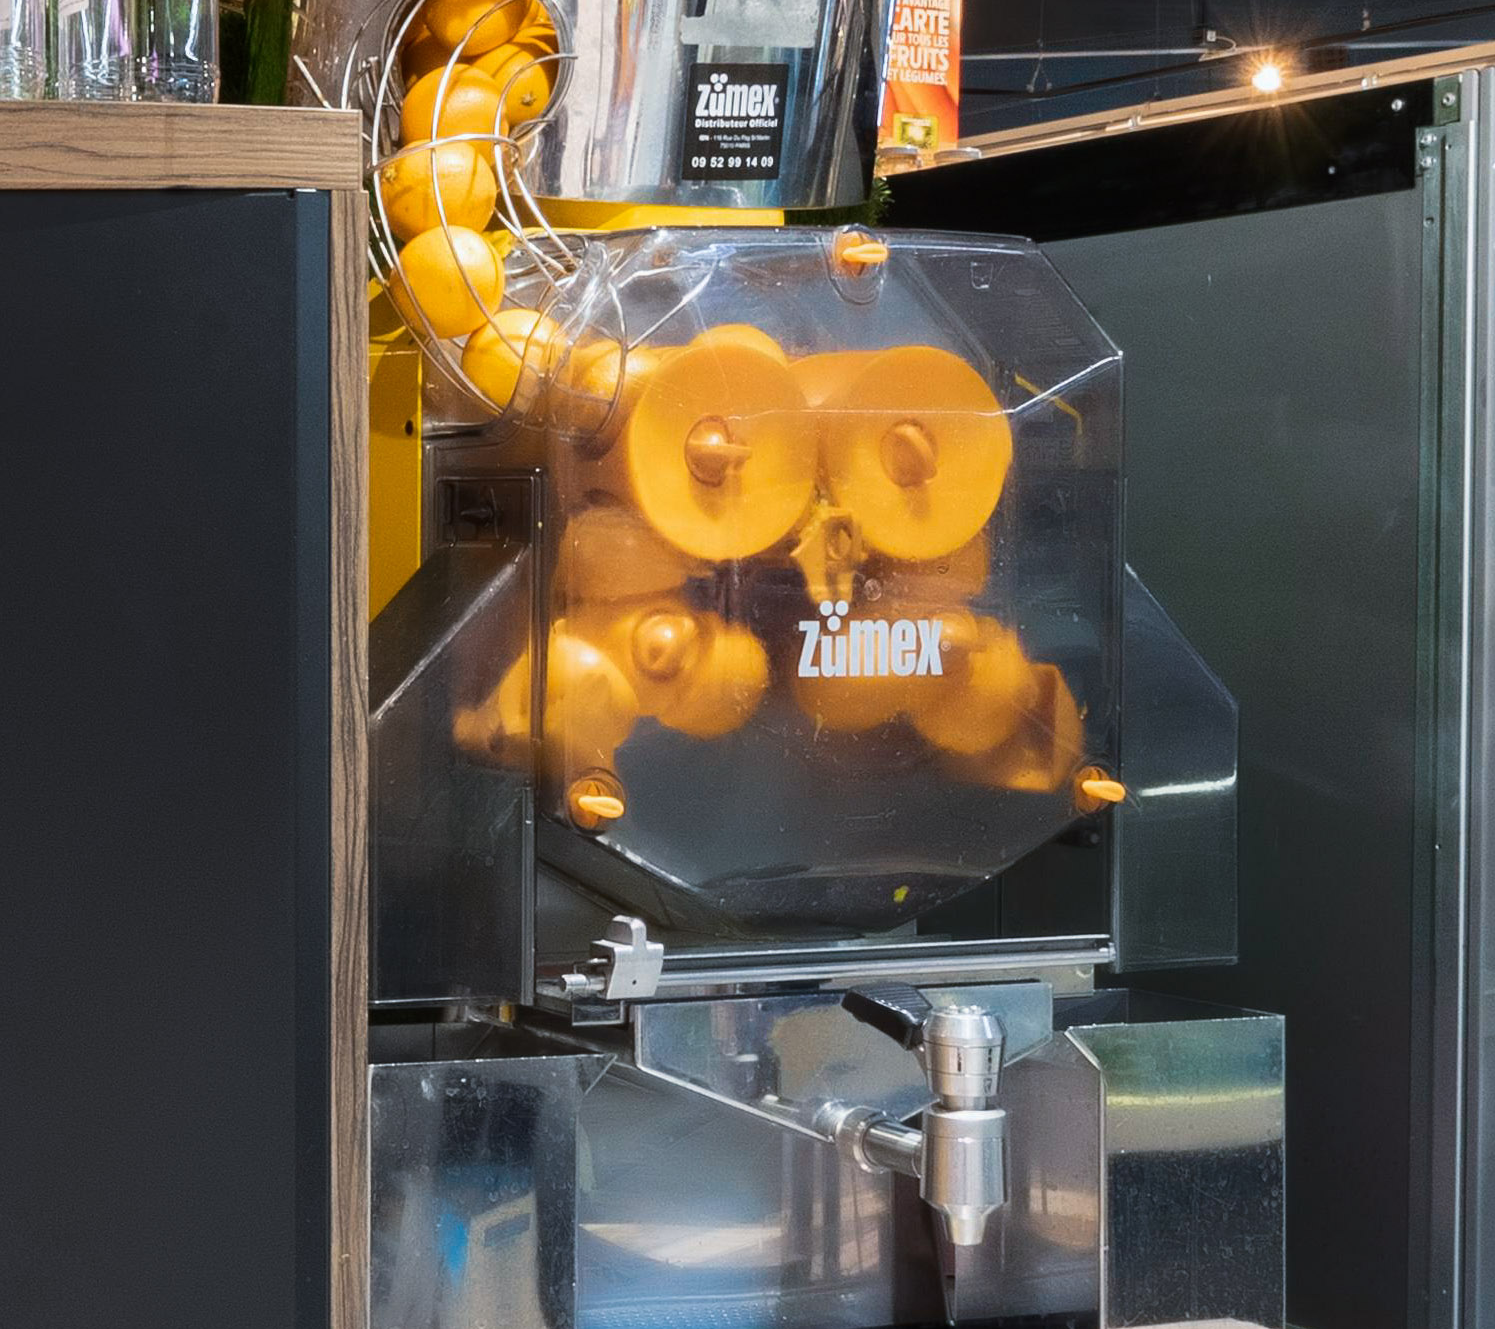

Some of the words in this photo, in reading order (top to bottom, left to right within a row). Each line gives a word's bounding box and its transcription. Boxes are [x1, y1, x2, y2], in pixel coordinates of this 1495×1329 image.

[695, 119, 748, 128] Distributeur
[749, 119, 778, 128] Officiel
[691, 156, 707, 168] 09
[728, 156, 742, 168] 99
[746, 156, 758, 168] 14
[761, 156, 774, 168] 09
